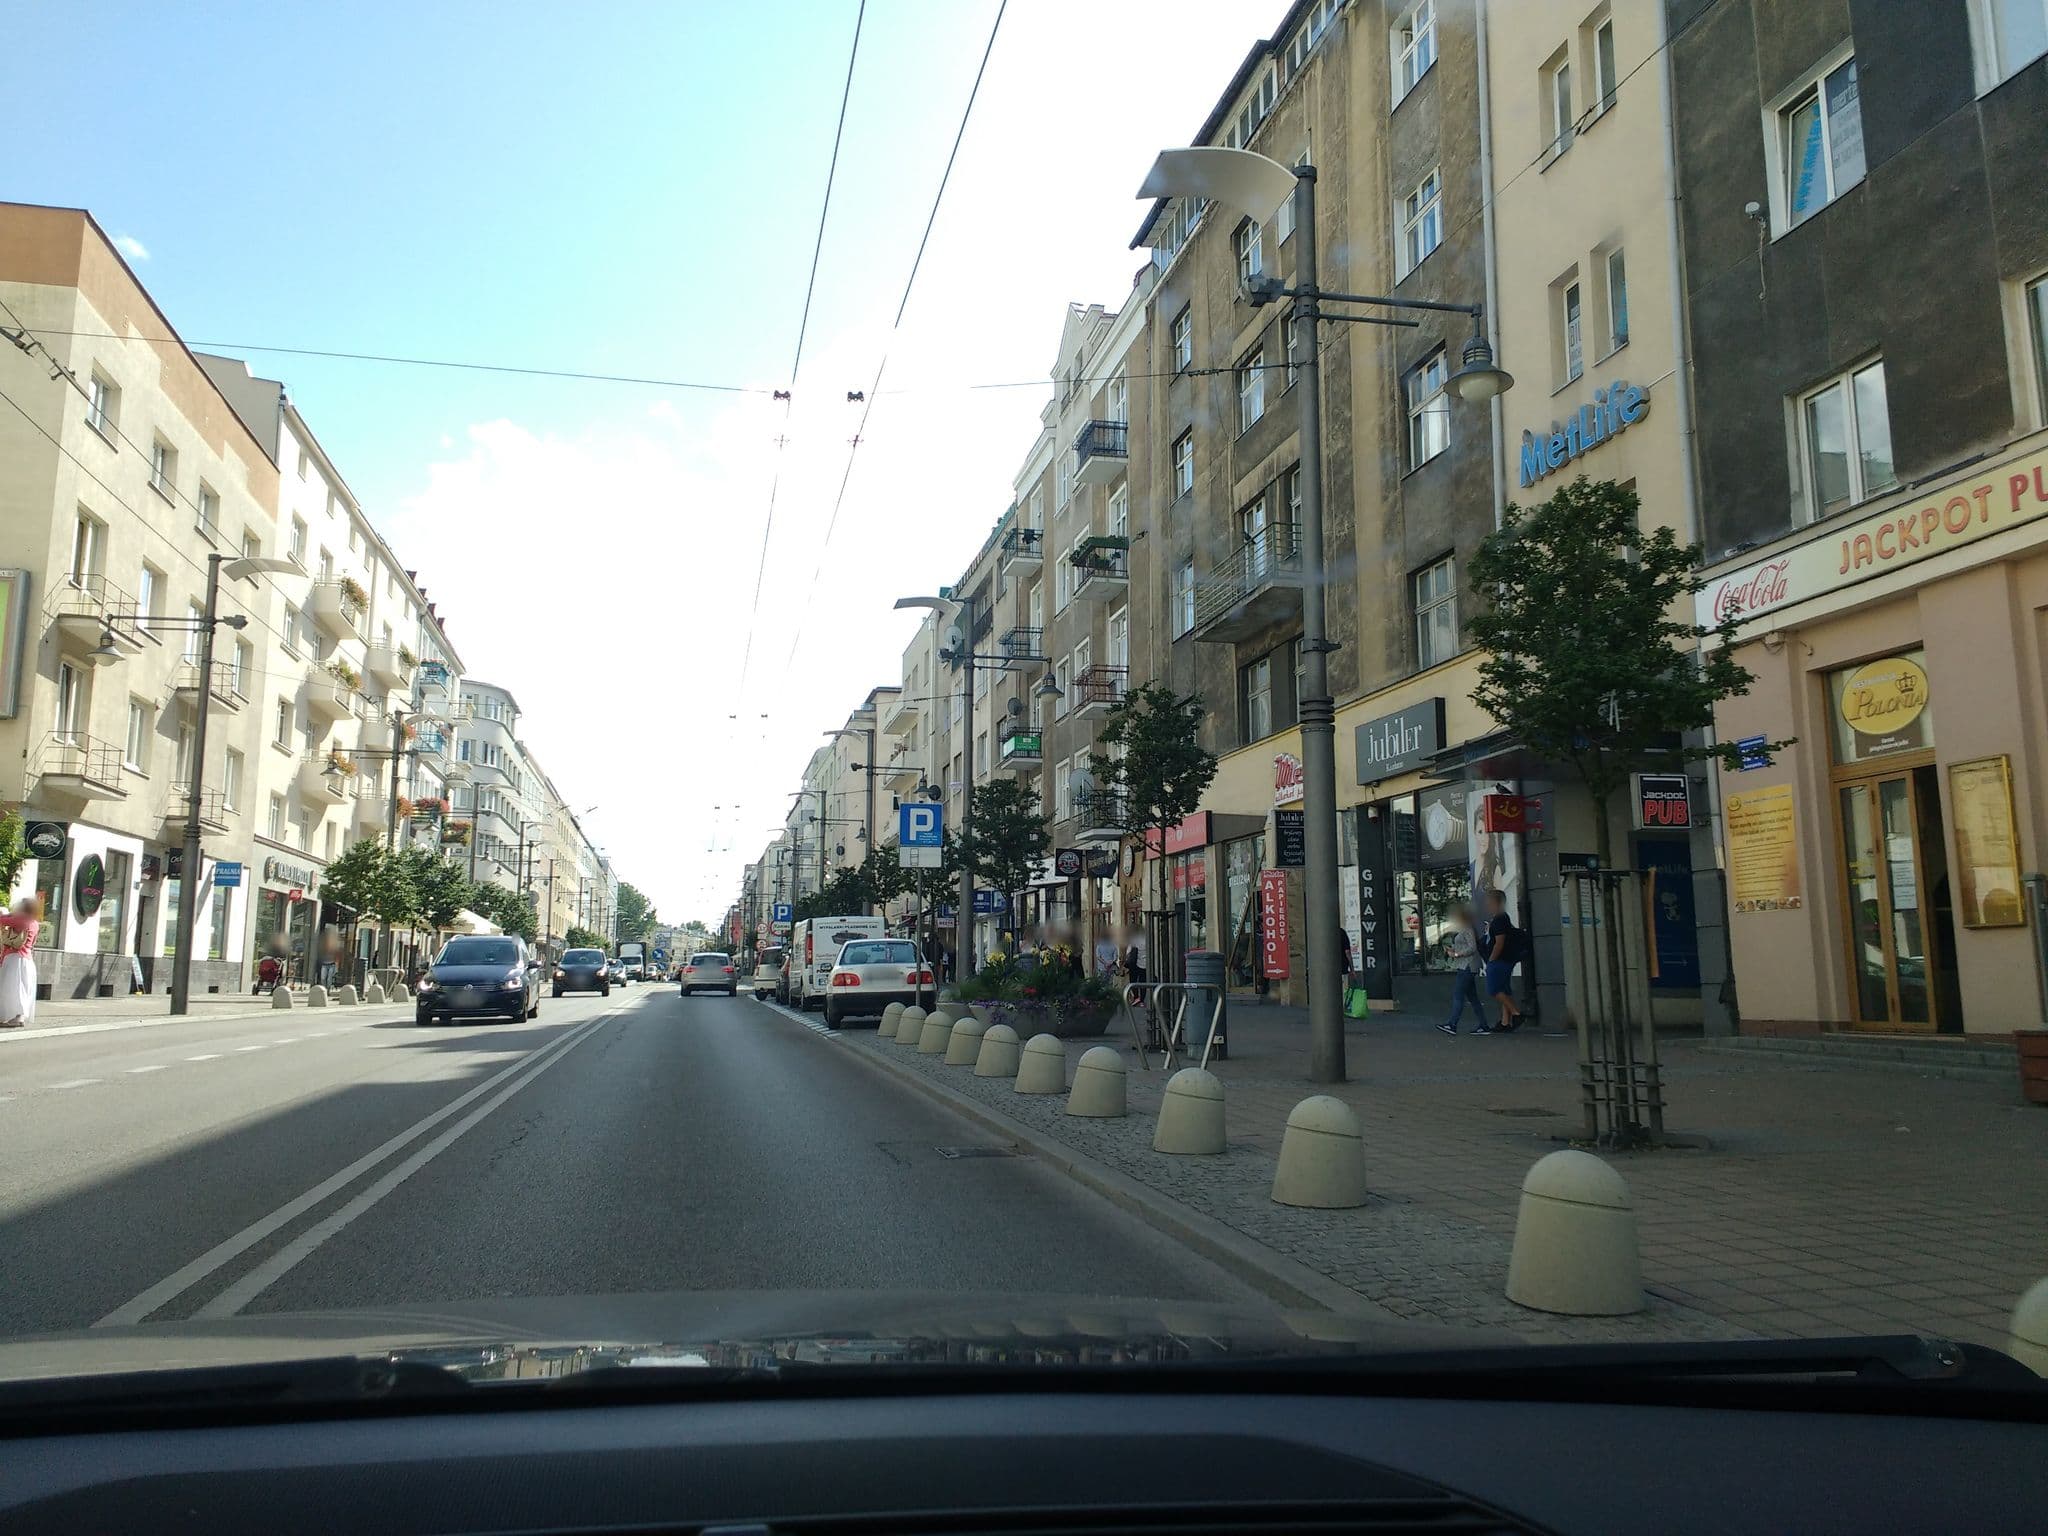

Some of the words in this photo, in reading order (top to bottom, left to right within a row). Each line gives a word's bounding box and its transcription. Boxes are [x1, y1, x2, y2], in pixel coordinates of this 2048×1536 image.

[1520, 379, 1650, 488] MetLife
[1839, 484, 1993, 575] JACKPOT
[909, 807, 934, 841] P
[1644, 799, 1688, 825] PUB
[777, 906, 788, 920] P
[1264, 880, 1277, 965] ALKOHOL
[1277, 879, 1286, 943] PAPIEROSY
[1361, 869, 1377, 969] GRAWER
